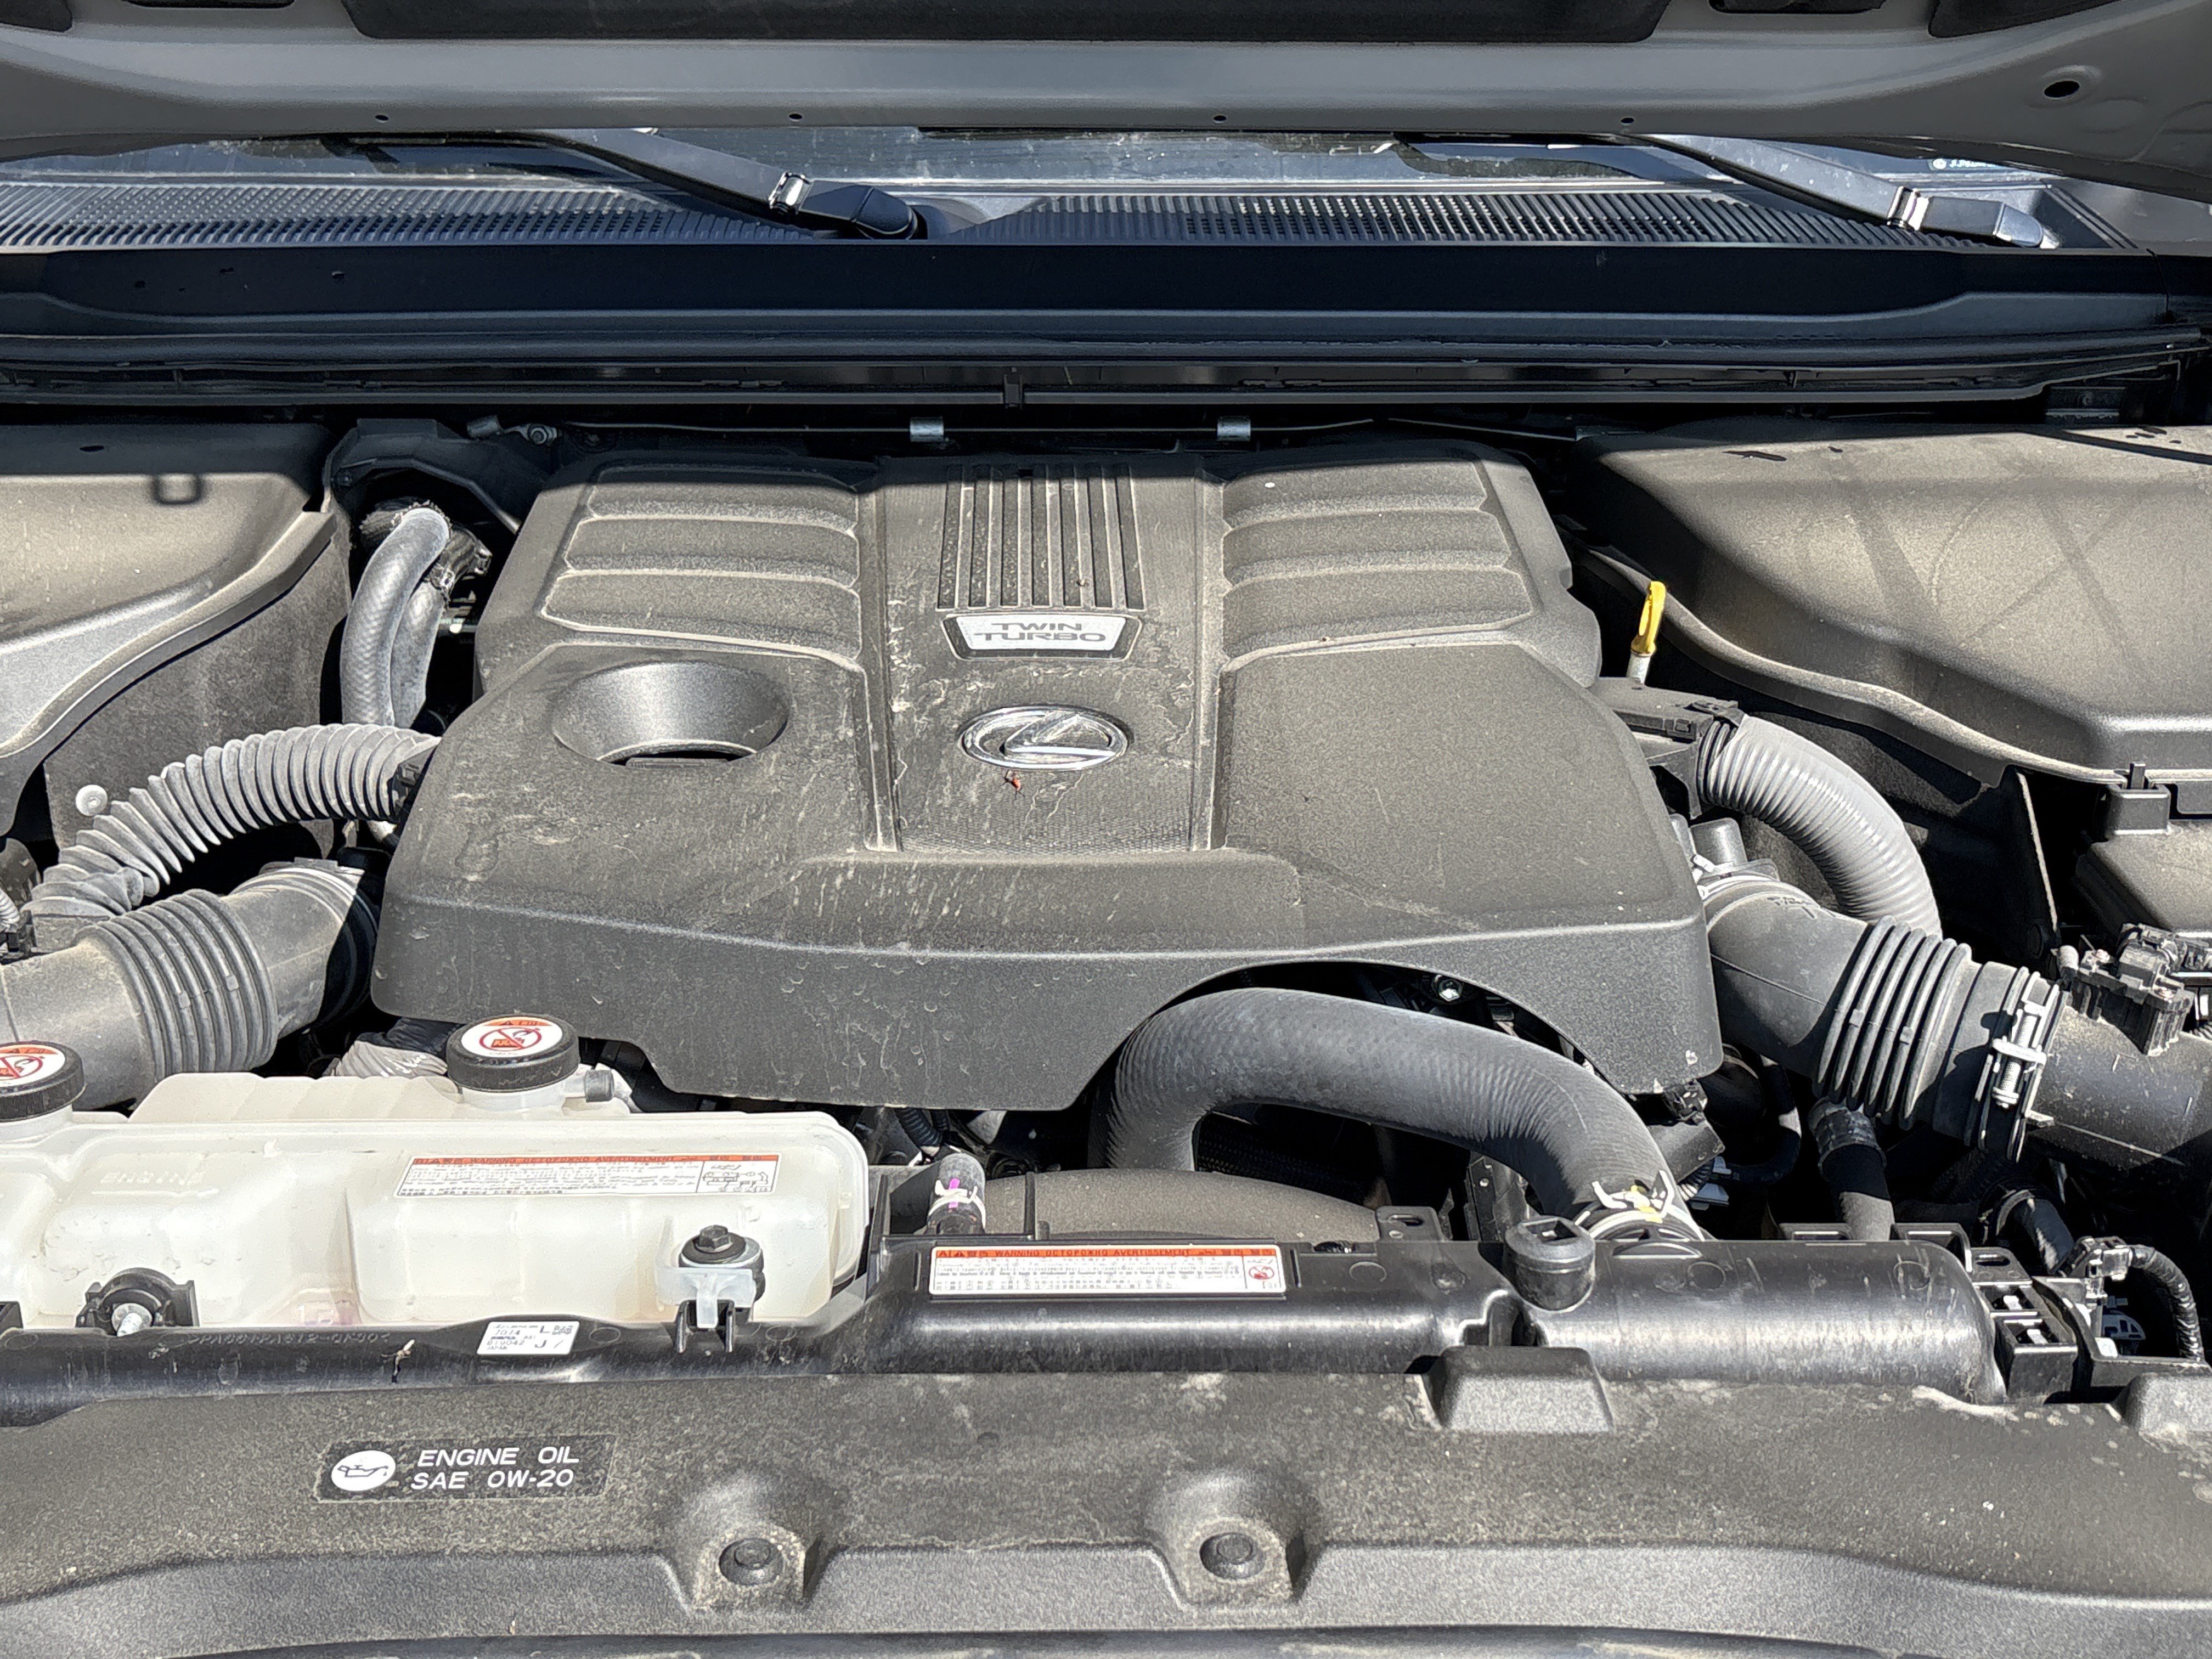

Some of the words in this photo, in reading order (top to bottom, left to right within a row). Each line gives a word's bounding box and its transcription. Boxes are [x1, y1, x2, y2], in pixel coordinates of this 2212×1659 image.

[991, 623, 1082, 631] TWIN
[974, 632, 1106, 642] TURBO
[417, 1447, 520, 1467] ENGINE
[538, 1446, 579, 1464] OIL
[410, 1471, 469, 1489] SAE
[487, 1469, 575, 1488] 0W-20
